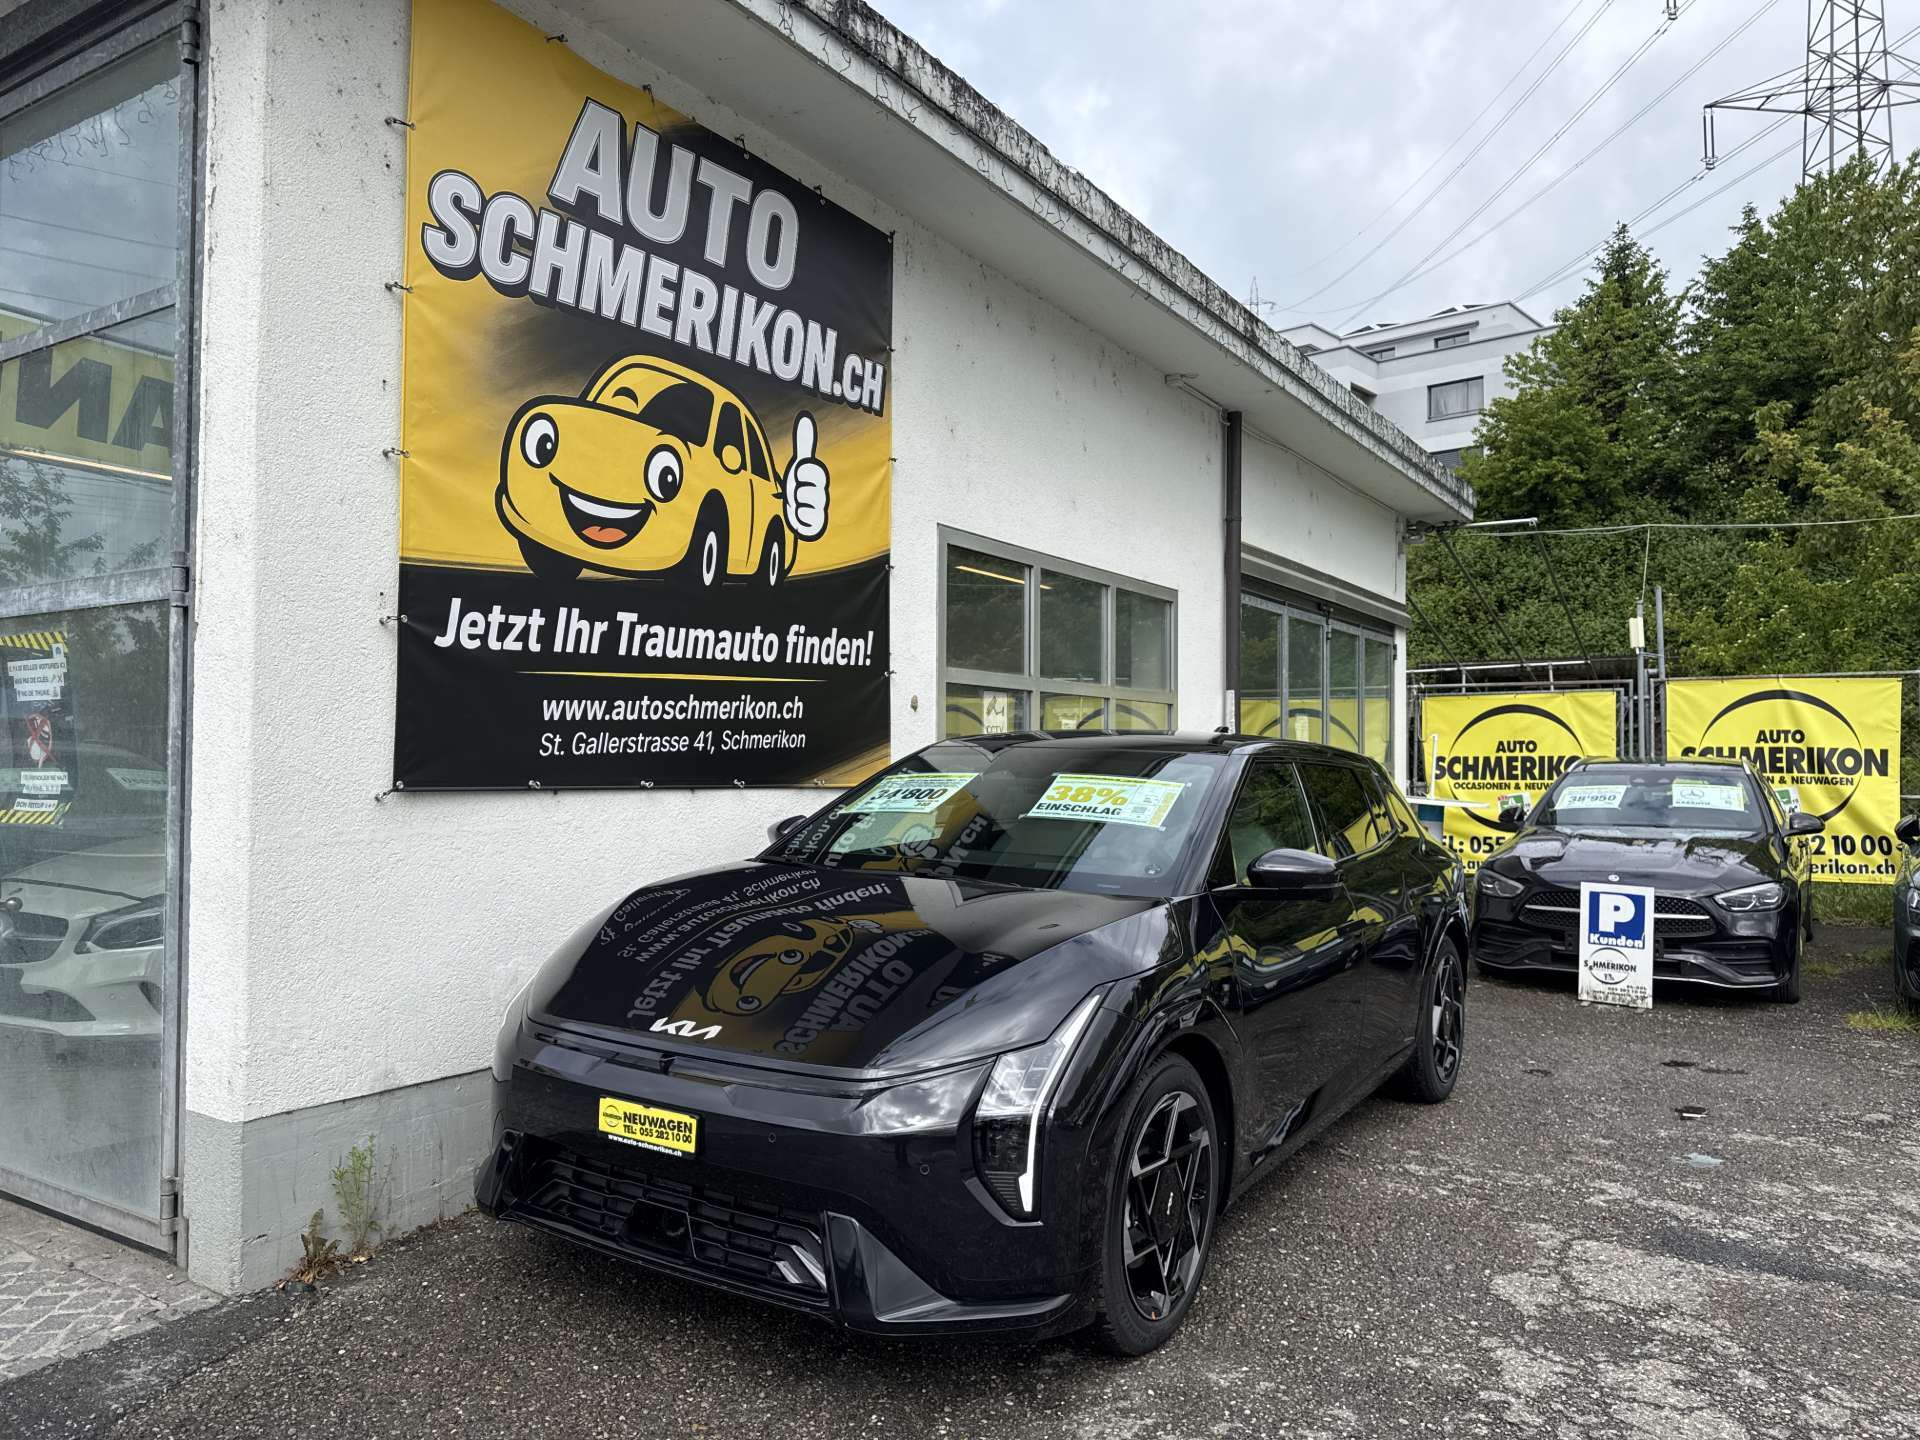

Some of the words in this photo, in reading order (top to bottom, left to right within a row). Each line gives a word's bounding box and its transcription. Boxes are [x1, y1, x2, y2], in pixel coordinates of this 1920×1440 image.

[549, 97, 800, 291] AUTO
[422, 170, 886, 412] SCHMERIKON.CH
[435, 598, 544, 651] Jetzt
[554, 607, 609, 655] Ihr
[616, 611, 779, 663] Traumauto
[786, 627, 874, 666] finden!
[542, 695, 803, 721] www.autoschmerikon.ch
[539, 733, 565, 756] St.
[572, 731, 689, 755] Gallerstrasse
[694, 731, 716, 754] 41,
[721, 730, 806, 750] Schmerikon
[1496, 740, 1537, 753] AUTO
[1756, 729, 1805, 744] AUTO
[1435, 756, 1582, 780] SCHMERIK
[1454, 782, 1511, 790] OCCASIONEN
[1514, 782, 1521, 790] &
[1525, 782, 1553, 790] NEUW
[1779, 776, 1787, 784] &
[1791, 776, 1854, 786] NEUWAGEN
[1046, 785, 1128, 806] 38%
[1036, 802, 1122, 816] EINSCHLAG
[1832, 836, 1856, 855] 10
[1860, 835, 1893, 856] 00
[1810, 860, 1896, 875] erikon.ch
[1598, 893, 1636, 933] P
[1589, 933, 1643, 948] Kunden
[1584, 960, 1637, 973] SHMERIKON
[623, 1112, 692, 1134] NEUWAGEN
[623, 1125, 637, 1135] TEL:
[639, 1127, 653, 1138] 055
[655, 1129, 669, 1140] 282
[671, 1132, 681, 1142] 10
[682, 1134, 692, 1144] 00
